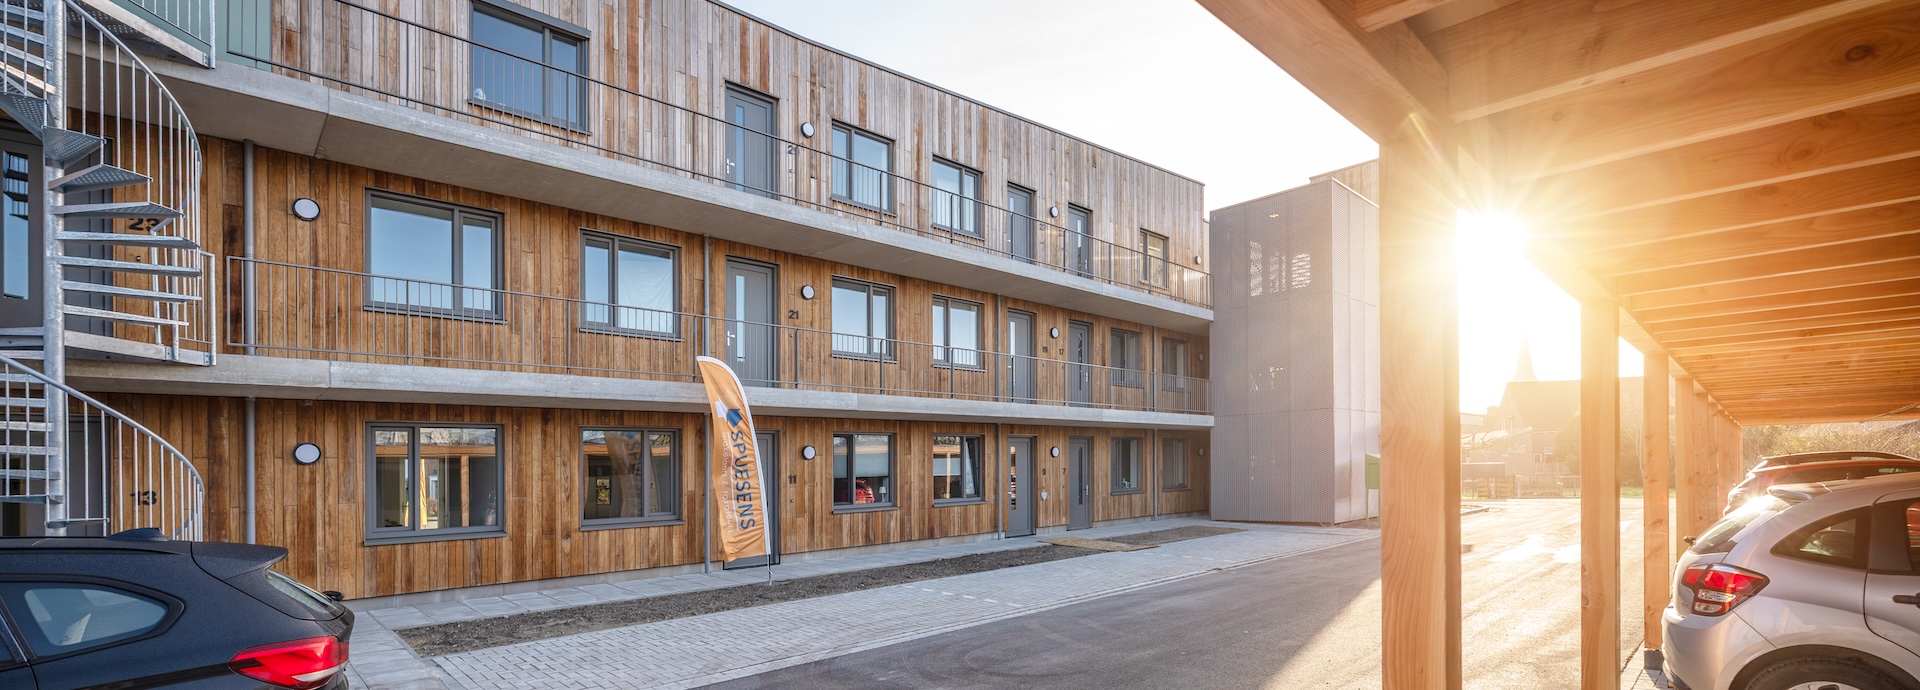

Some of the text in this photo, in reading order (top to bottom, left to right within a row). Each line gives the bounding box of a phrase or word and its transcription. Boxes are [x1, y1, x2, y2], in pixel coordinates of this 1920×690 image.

[788, 309, 799, 320] 21
[721, 432, 729, 477] makelaars
[732, 430, 755, 530] SPUESENS
[788, 474, 797, 485] 11
[130, 490, 157, 506] 13
[721, 490, 733, 533] taxateurs
